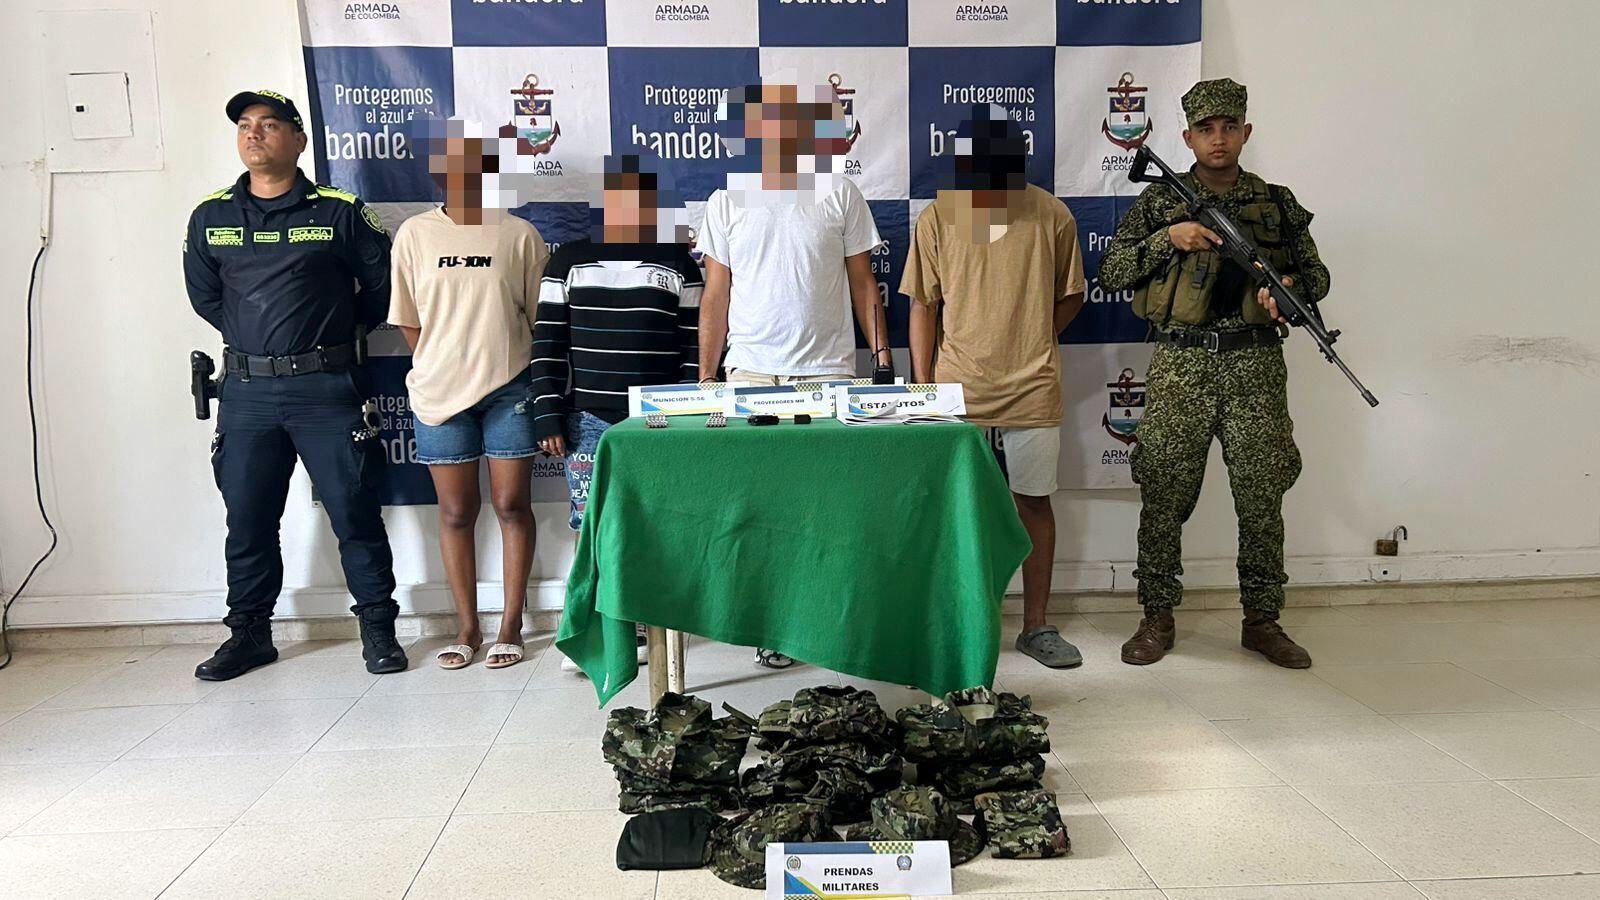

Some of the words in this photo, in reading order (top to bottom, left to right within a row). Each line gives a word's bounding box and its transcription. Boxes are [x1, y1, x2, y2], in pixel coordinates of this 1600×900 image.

[345, 3, 400, 13] ARMADA
[656, 4, 709, 14] ARMADA
[956, 5, 1008, 15] ARMADA
[335, 84, 434, 109] Protegemos
[645, 84, 729, 109] Protegem
[943, 83, 1035, 103] Protegemos
[366, 108, 377, 124] el
[380, 108, 404, 124] azul
[674, 108, 684, 124] el
[687, 108, 710, 124] azul
[1025, 106, 1035, 122] la
[325, 124, 414, 161] bande
[631, 124, 734, 159] bander
[533, 161, 563, 170] ADA
[1102, 155, 1136, 165] ARMA
[881, 259, 890, 273] la
[824, 867, 874, 876] PRENDAS
[822, 883, 880, 892] MILITARES
